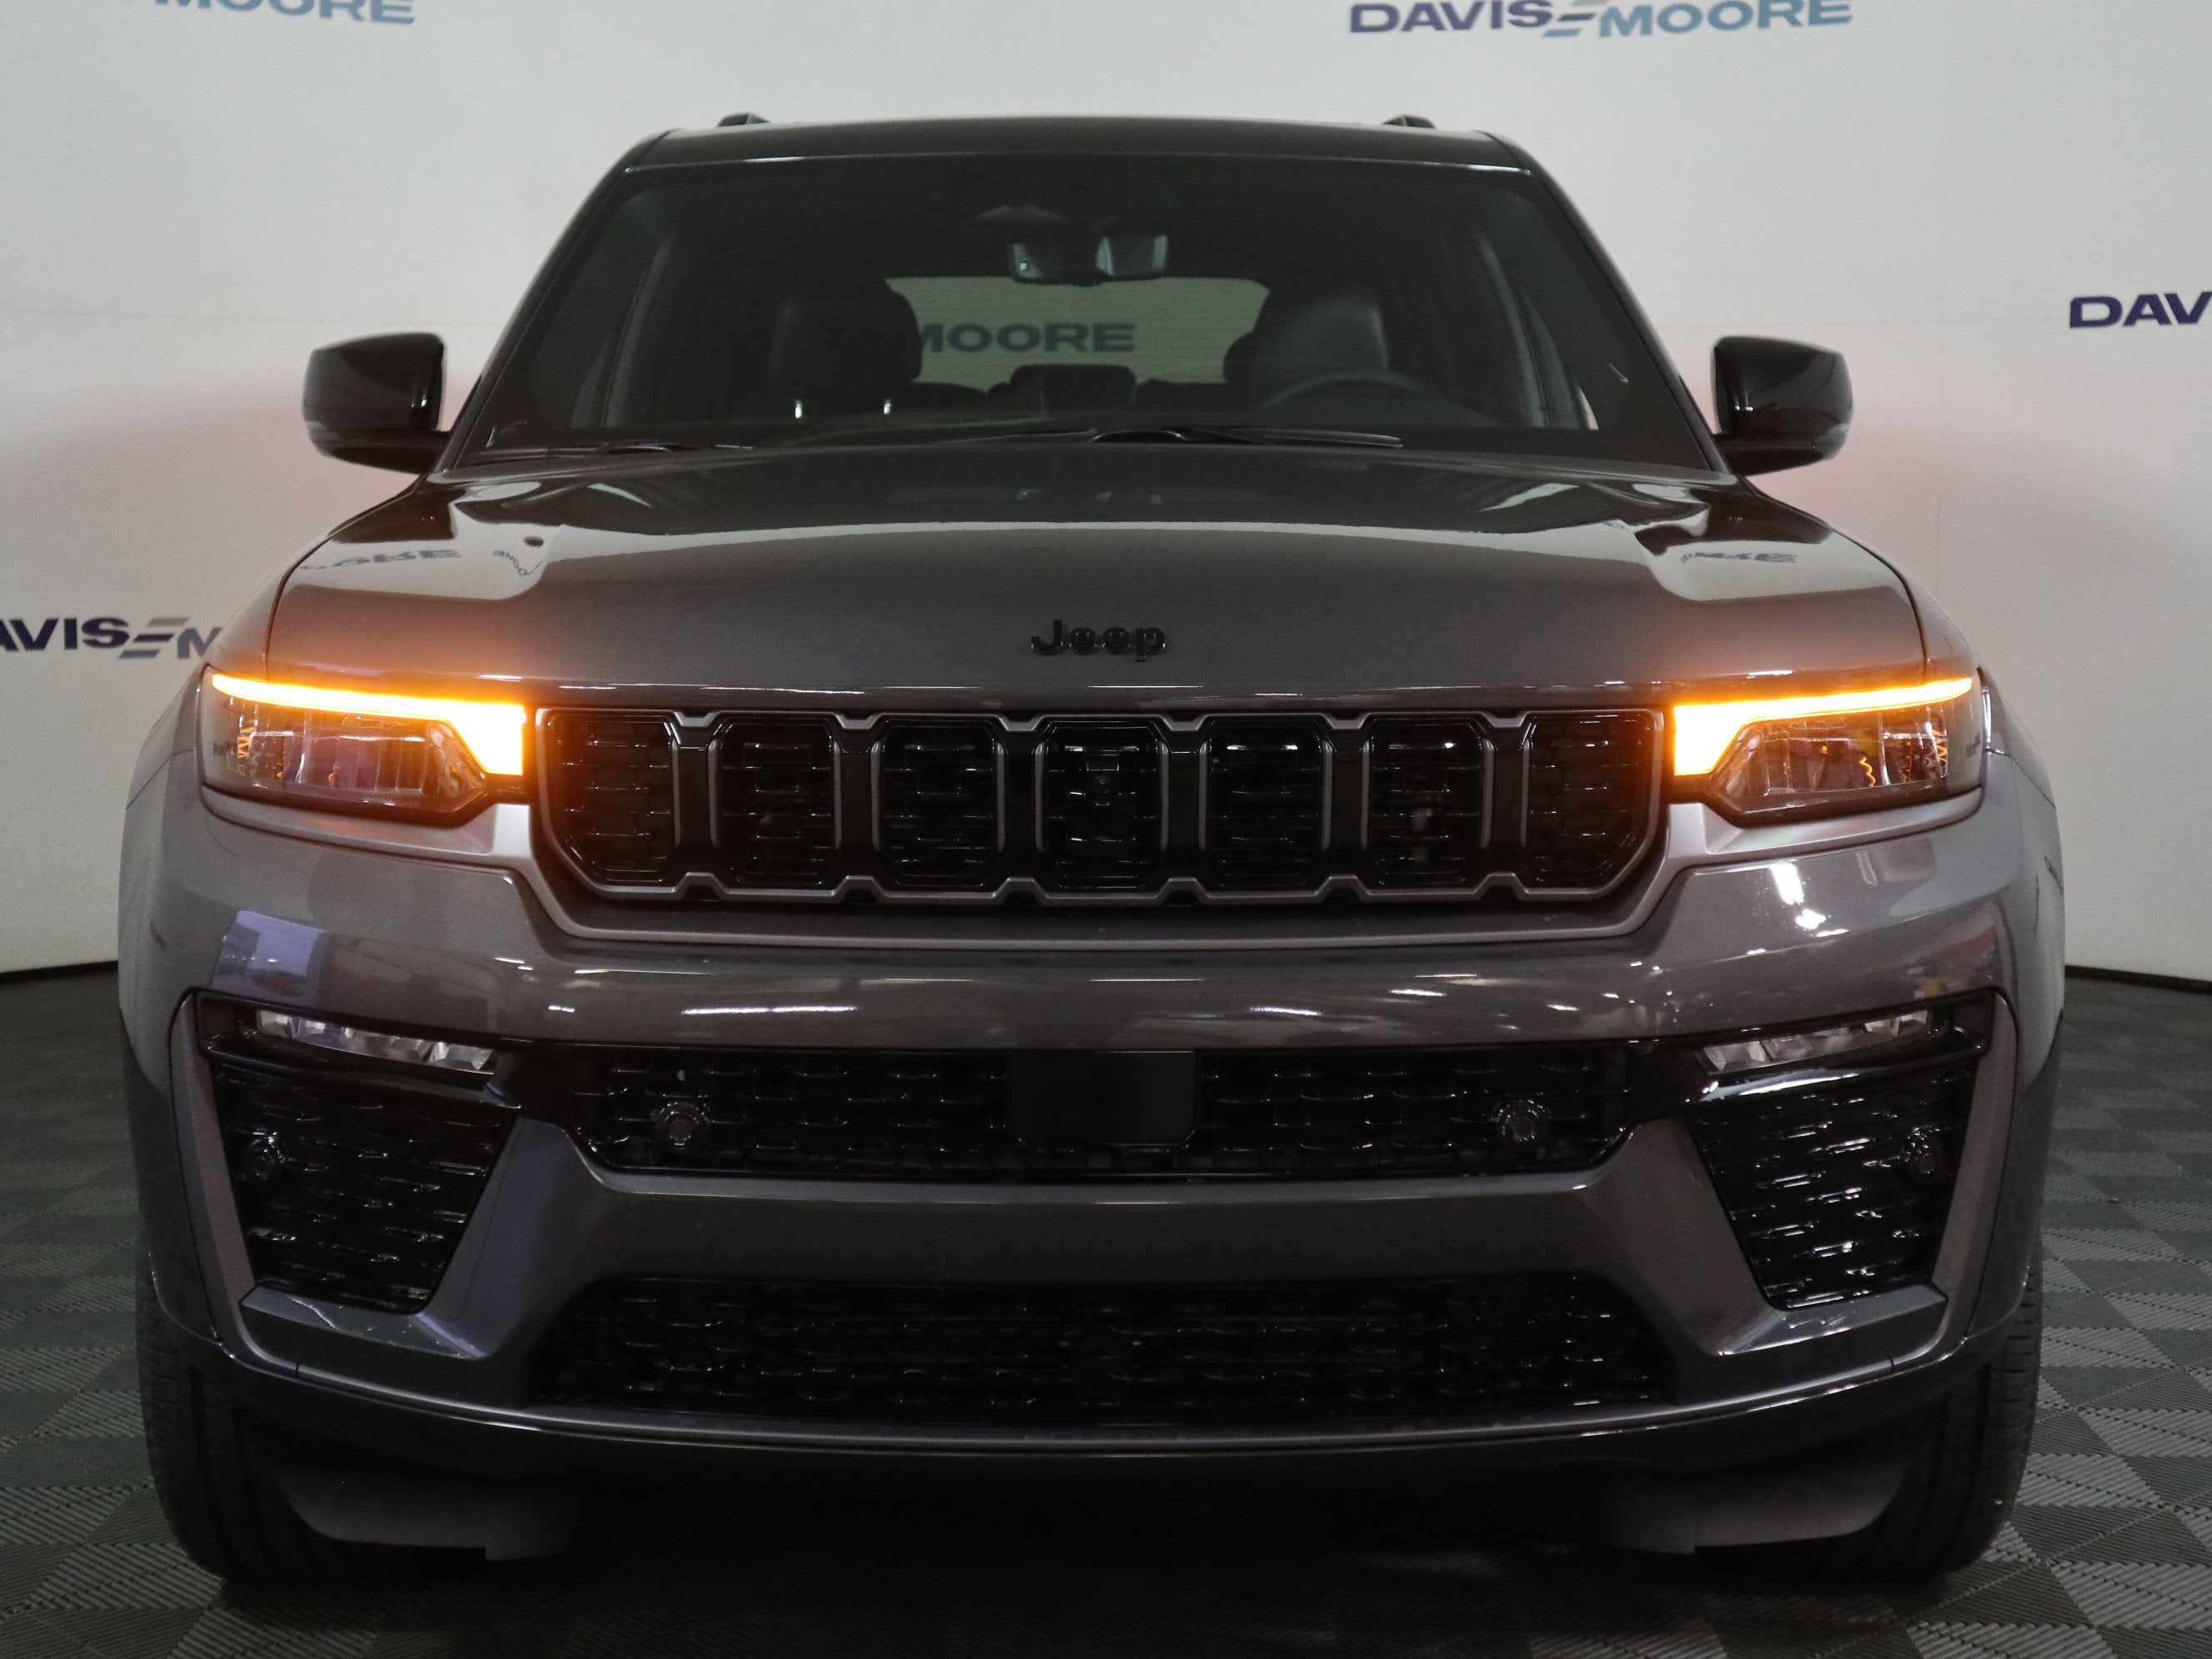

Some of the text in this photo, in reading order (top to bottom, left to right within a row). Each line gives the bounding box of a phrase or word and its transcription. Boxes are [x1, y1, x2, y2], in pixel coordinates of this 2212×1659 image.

[1350, 0, 1853, 37] DAVIS MOORE
[1030, 619, 1166, 662] Jeep
